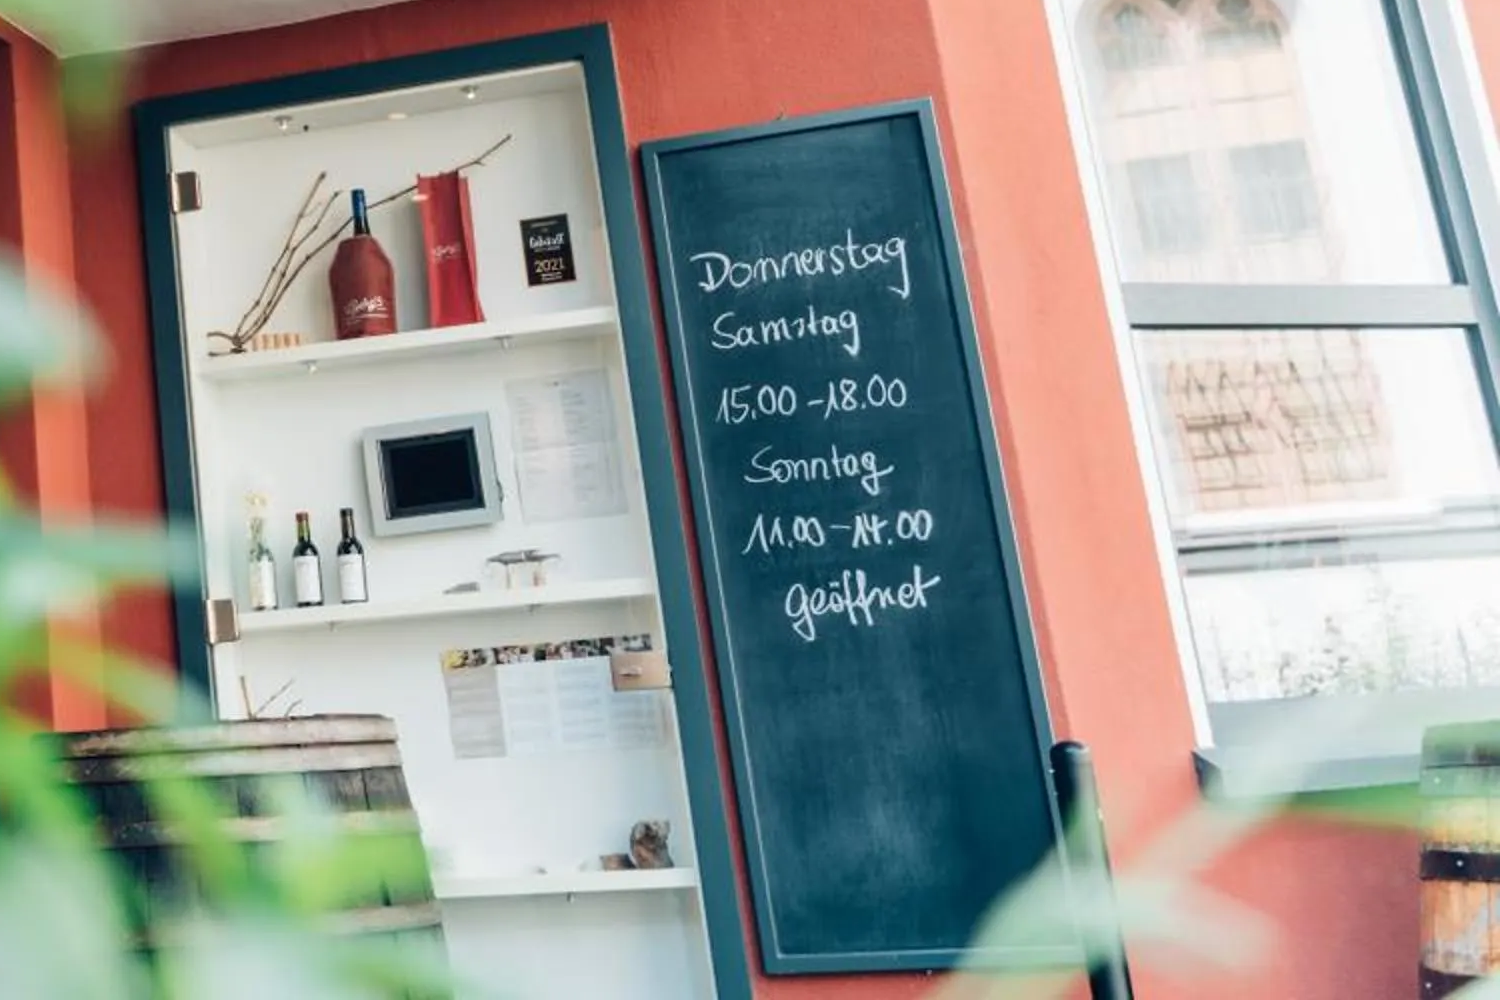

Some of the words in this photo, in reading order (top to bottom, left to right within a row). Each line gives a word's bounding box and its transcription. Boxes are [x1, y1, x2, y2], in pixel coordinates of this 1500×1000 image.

[690, 228, 910, 299] Donnerstag
[711, 305, 861, 357] Samstag
[743, 444, 894, 496] Sonntag
